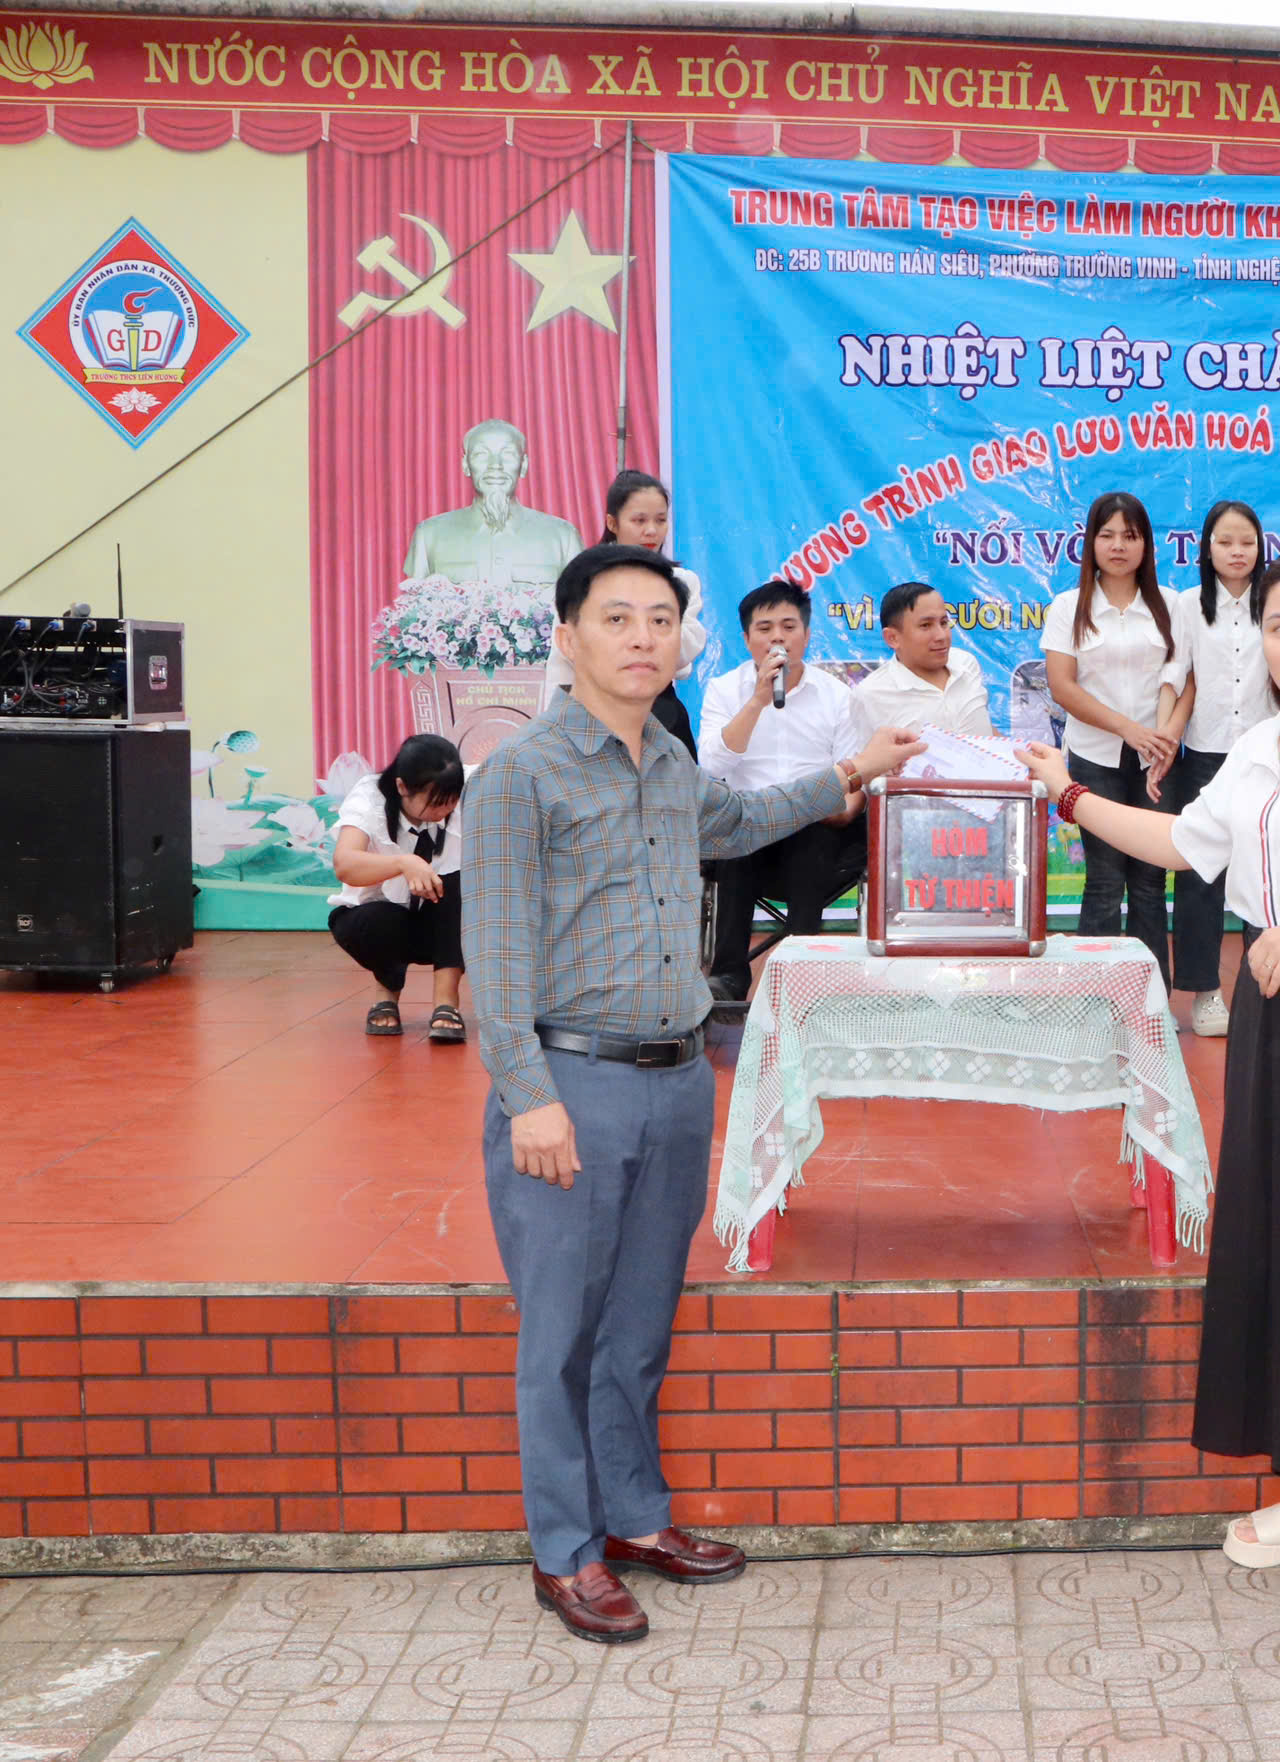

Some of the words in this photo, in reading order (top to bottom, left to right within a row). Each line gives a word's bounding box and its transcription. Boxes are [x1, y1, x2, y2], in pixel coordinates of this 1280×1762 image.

[143, 31, 286, 87] NƯỚC
[301, 34, 446, 101] CỘNG
[460, 38, 571, 94] HÒA
[586, 45, 661, 96] XÃ
[677, 45, 769, 109] HỘI
[785, 45, 888, 104] CHỦ
[903, 61, 1070, 113] NGHĨA
[1085, 65, 1200, 128] VIỆT
[728, 188, 834, 229] TRUNG
[841, 187, 910, 230] TÂM
[917, 195, 979, 238] TẠO
[986, 191, 1057, 239] VIỆC
[1065, 193, 1132, 236] LÀM
[1141, 196, 1236, 239] NGƯỜI
[755, 248, 784, 272] ĐC:
[788, 248, 821, 272] 25B
[826, 249, 895, 274] TRƯƠNG
[900, 245, 936, 275] HÁN
[940, 249, 984, 279] SIÊU,
[990, 250, 1060, 278] PHƯỜNG
[1064, 250, 1132, 278] TRƯỜNG
[1136, 255, 1177, 280] VINH
[1193, 253, 1232, 281] TỈNH
[1236, 256, 1280, 286] NGHỆ
[75, 289, 89, 311] BAN
[88, 268, 114, 289] NHÂN
[106, 329, 126, 351] G
[141, 329, 162, 351] D
[839, 321, 1027, 401] NHIỆT
[1039, 325, 1172, 402] LIỆT
[770, 510, 870, 594] ƯƠNG
[862, 456, 966, 529] TRÌNH
[971, 430, 1049, 482] GIAO
[1056, 416, 1122, 459] LƯU
[1129, 403, 1194, 449] VĂN
[1206, 406, 1272, 453] HOÁ
[931, 820, 989, 857] HÒM
[905, 872, 939, 909] TỪ
[943, 872, 1015, 918] THIỆN
